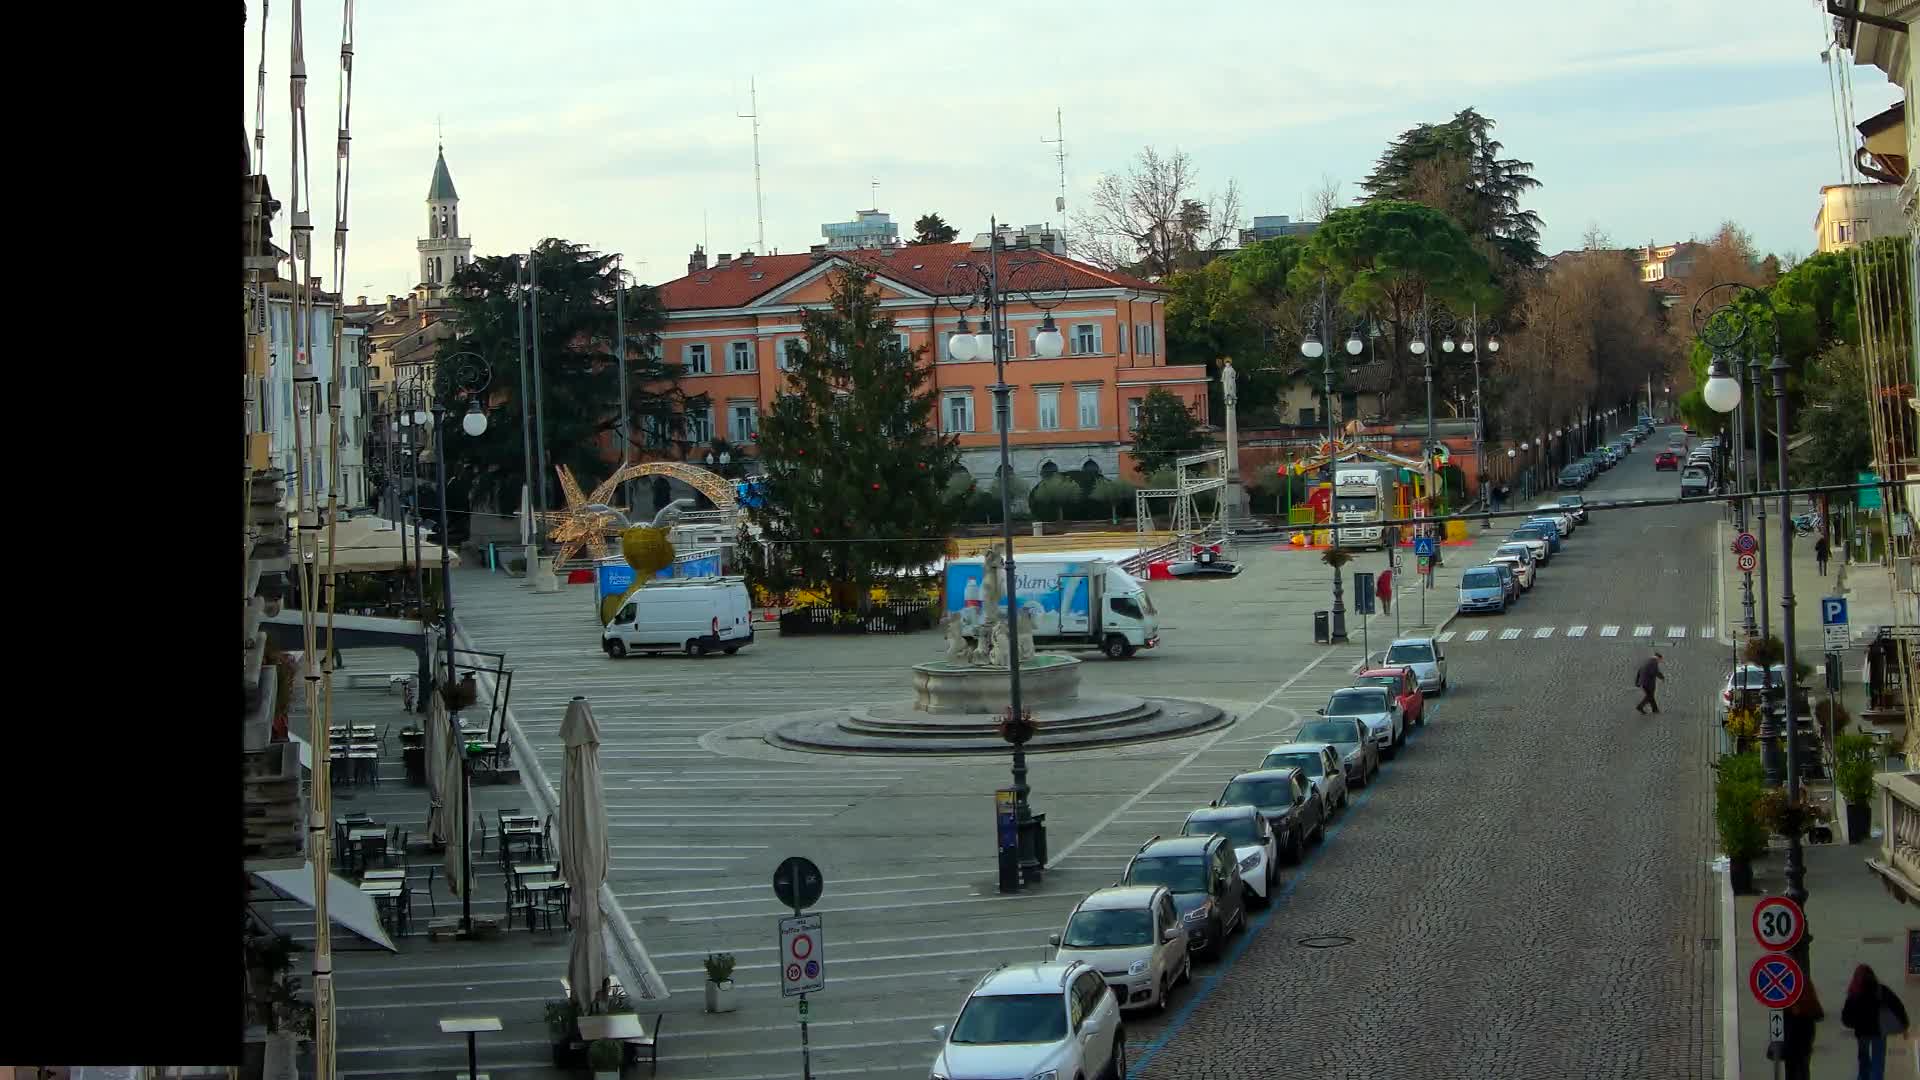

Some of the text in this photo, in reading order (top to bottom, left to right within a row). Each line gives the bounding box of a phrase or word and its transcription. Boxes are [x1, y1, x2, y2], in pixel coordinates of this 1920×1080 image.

[1743, 557, 1752, 567] 20
[1827, 602, 1842, 621] P
[1762, 911, 1792, 937] 30
